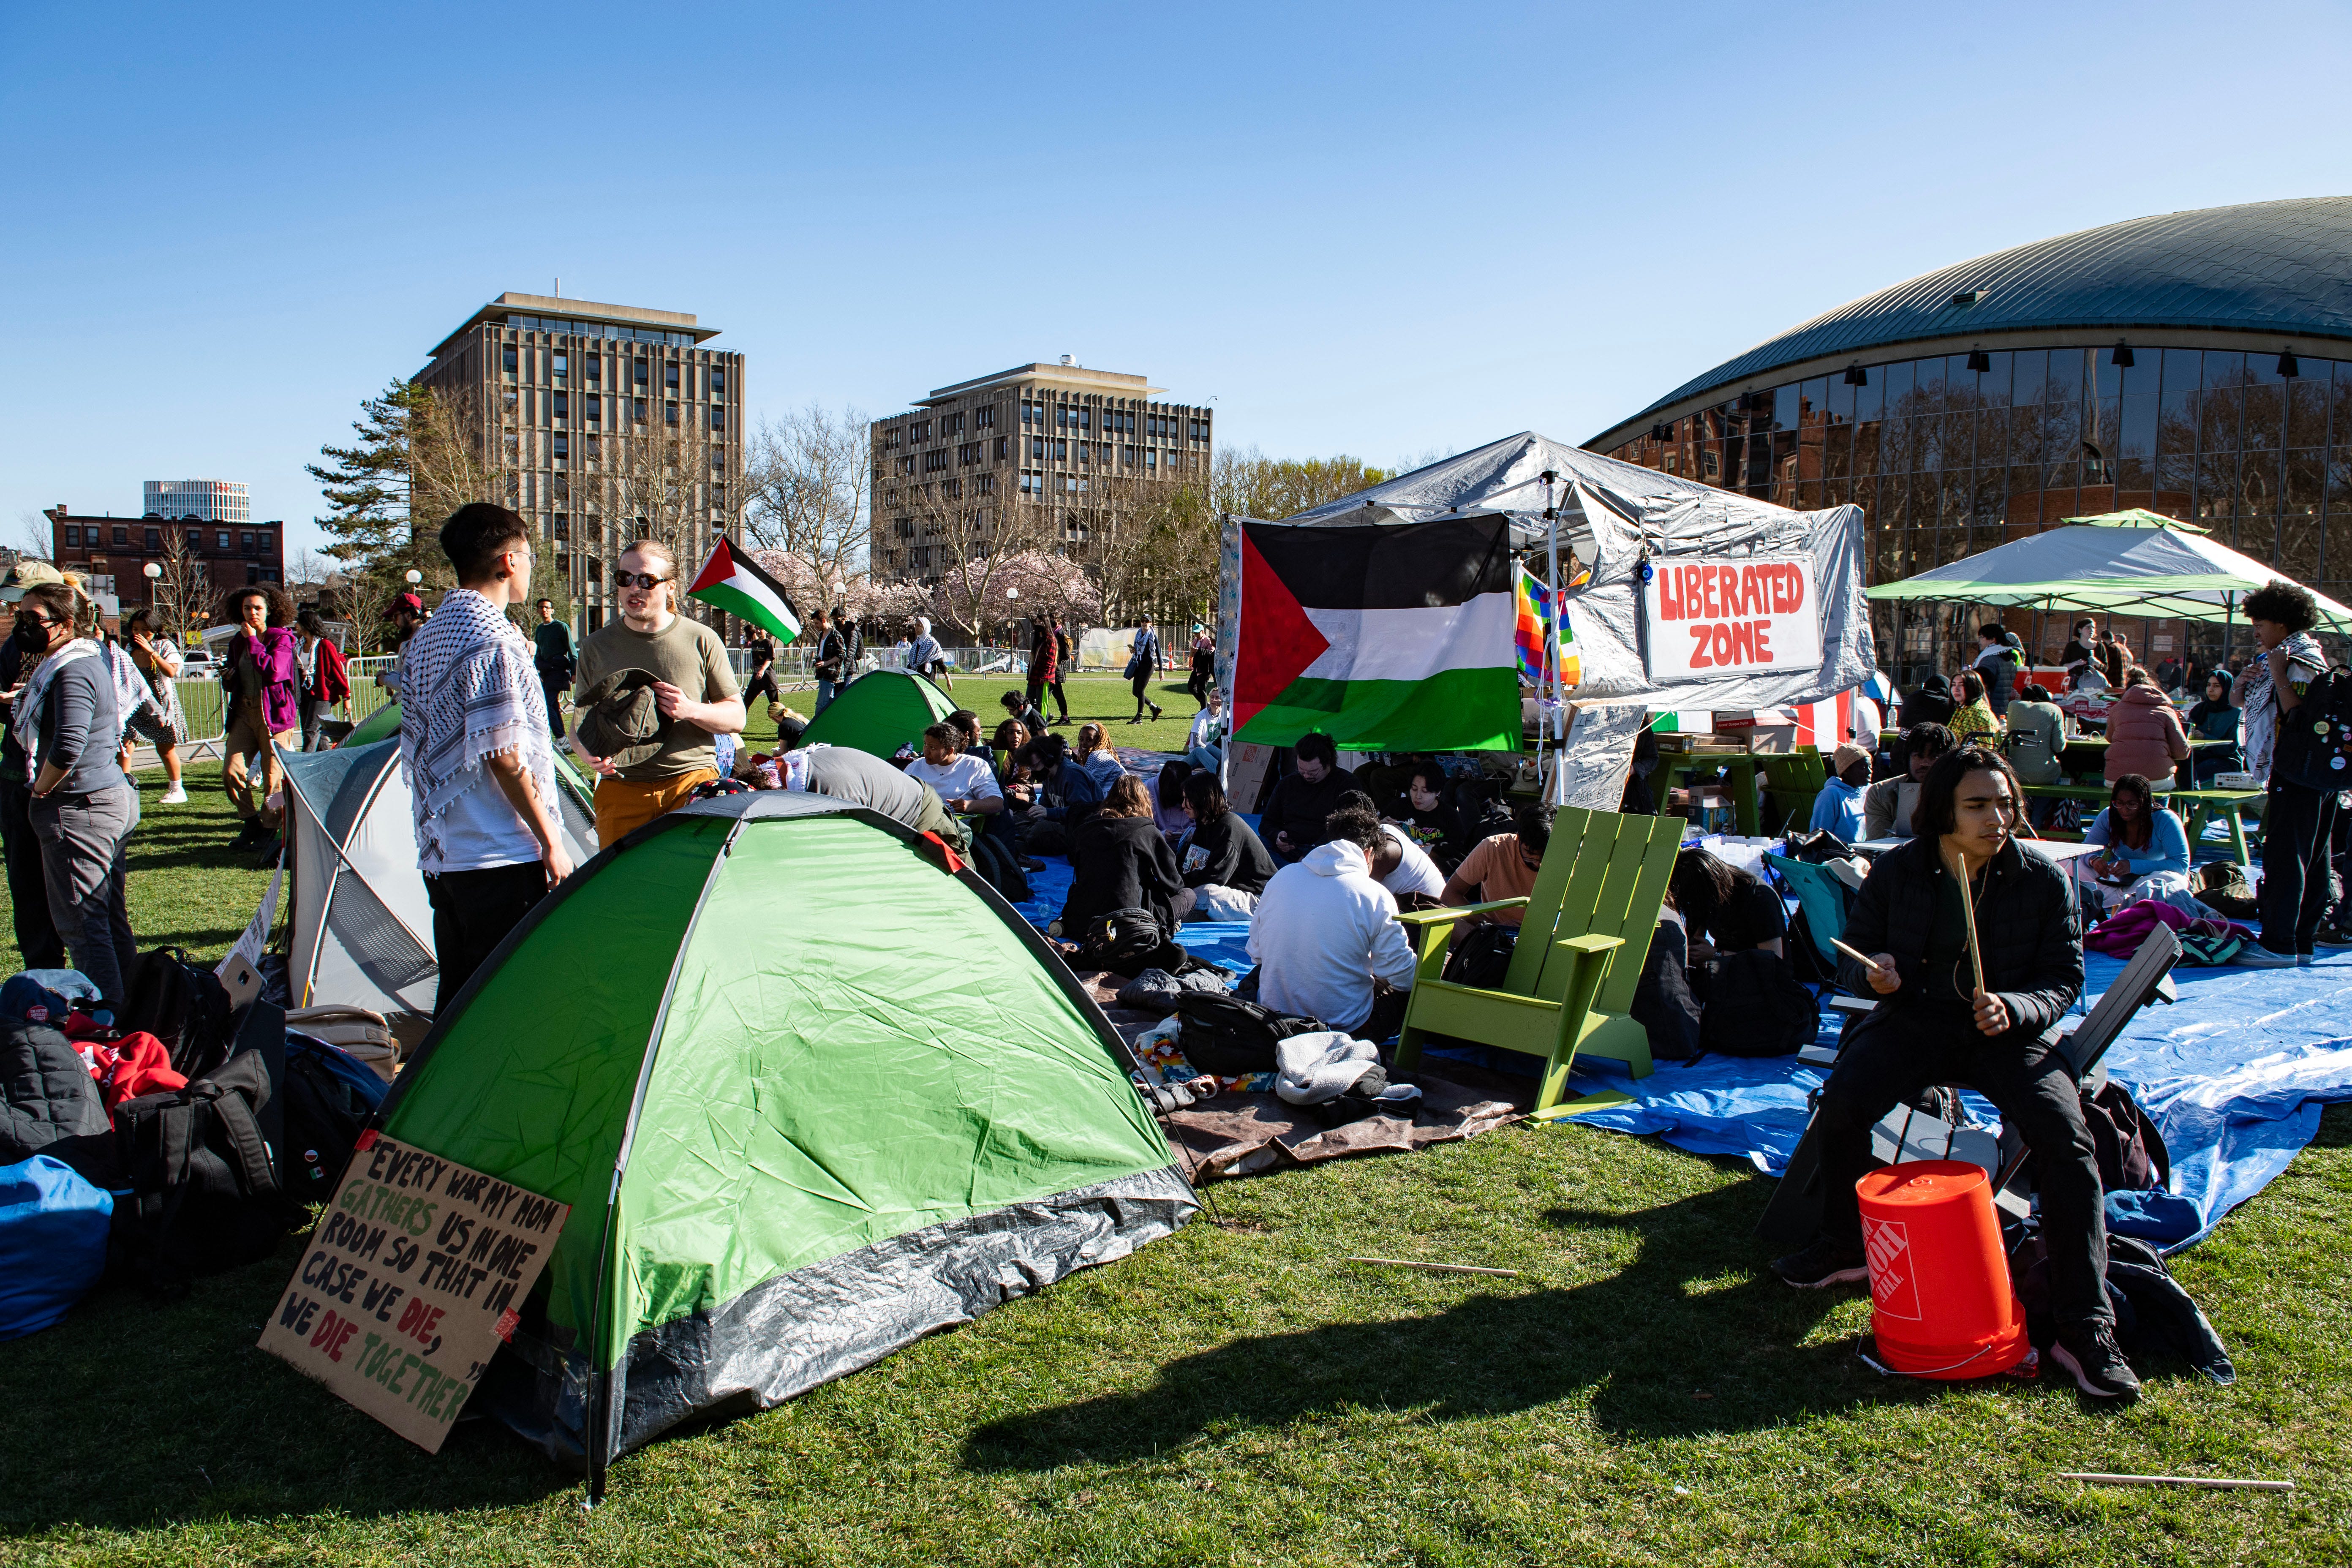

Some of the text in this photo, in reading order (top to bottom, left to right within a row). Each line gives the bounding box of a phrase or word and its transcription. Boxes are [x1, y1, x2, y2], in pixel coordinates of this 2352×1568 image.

[1659, 562, 1804, 621] LIBERATED
[1690, 620, 1773, 669] ZONE
[1575, 713, 1594, 727] IF
[1574, 767, 1615, 784] PEOPLE
[1575, 790, 1595, 804] THERE
[340, 1180, 537, 1280] GATHERS US IN ONE
[446, 1169, 490, 1205] WAR
[487, 1181, 519, 1220] MY
[512, 1200, 559, 1233] MOM
[302, 1251, 367, 1304] CASE
[363, 1278, 404, 1322] WE
[321, 1212, 518, 1316] ROOM SO THAT IN
[1876, 1269, 1904, 1303] THE
[280, 1292, 320, 1336] WE
[310, 1309, 359, 1363] DIE
